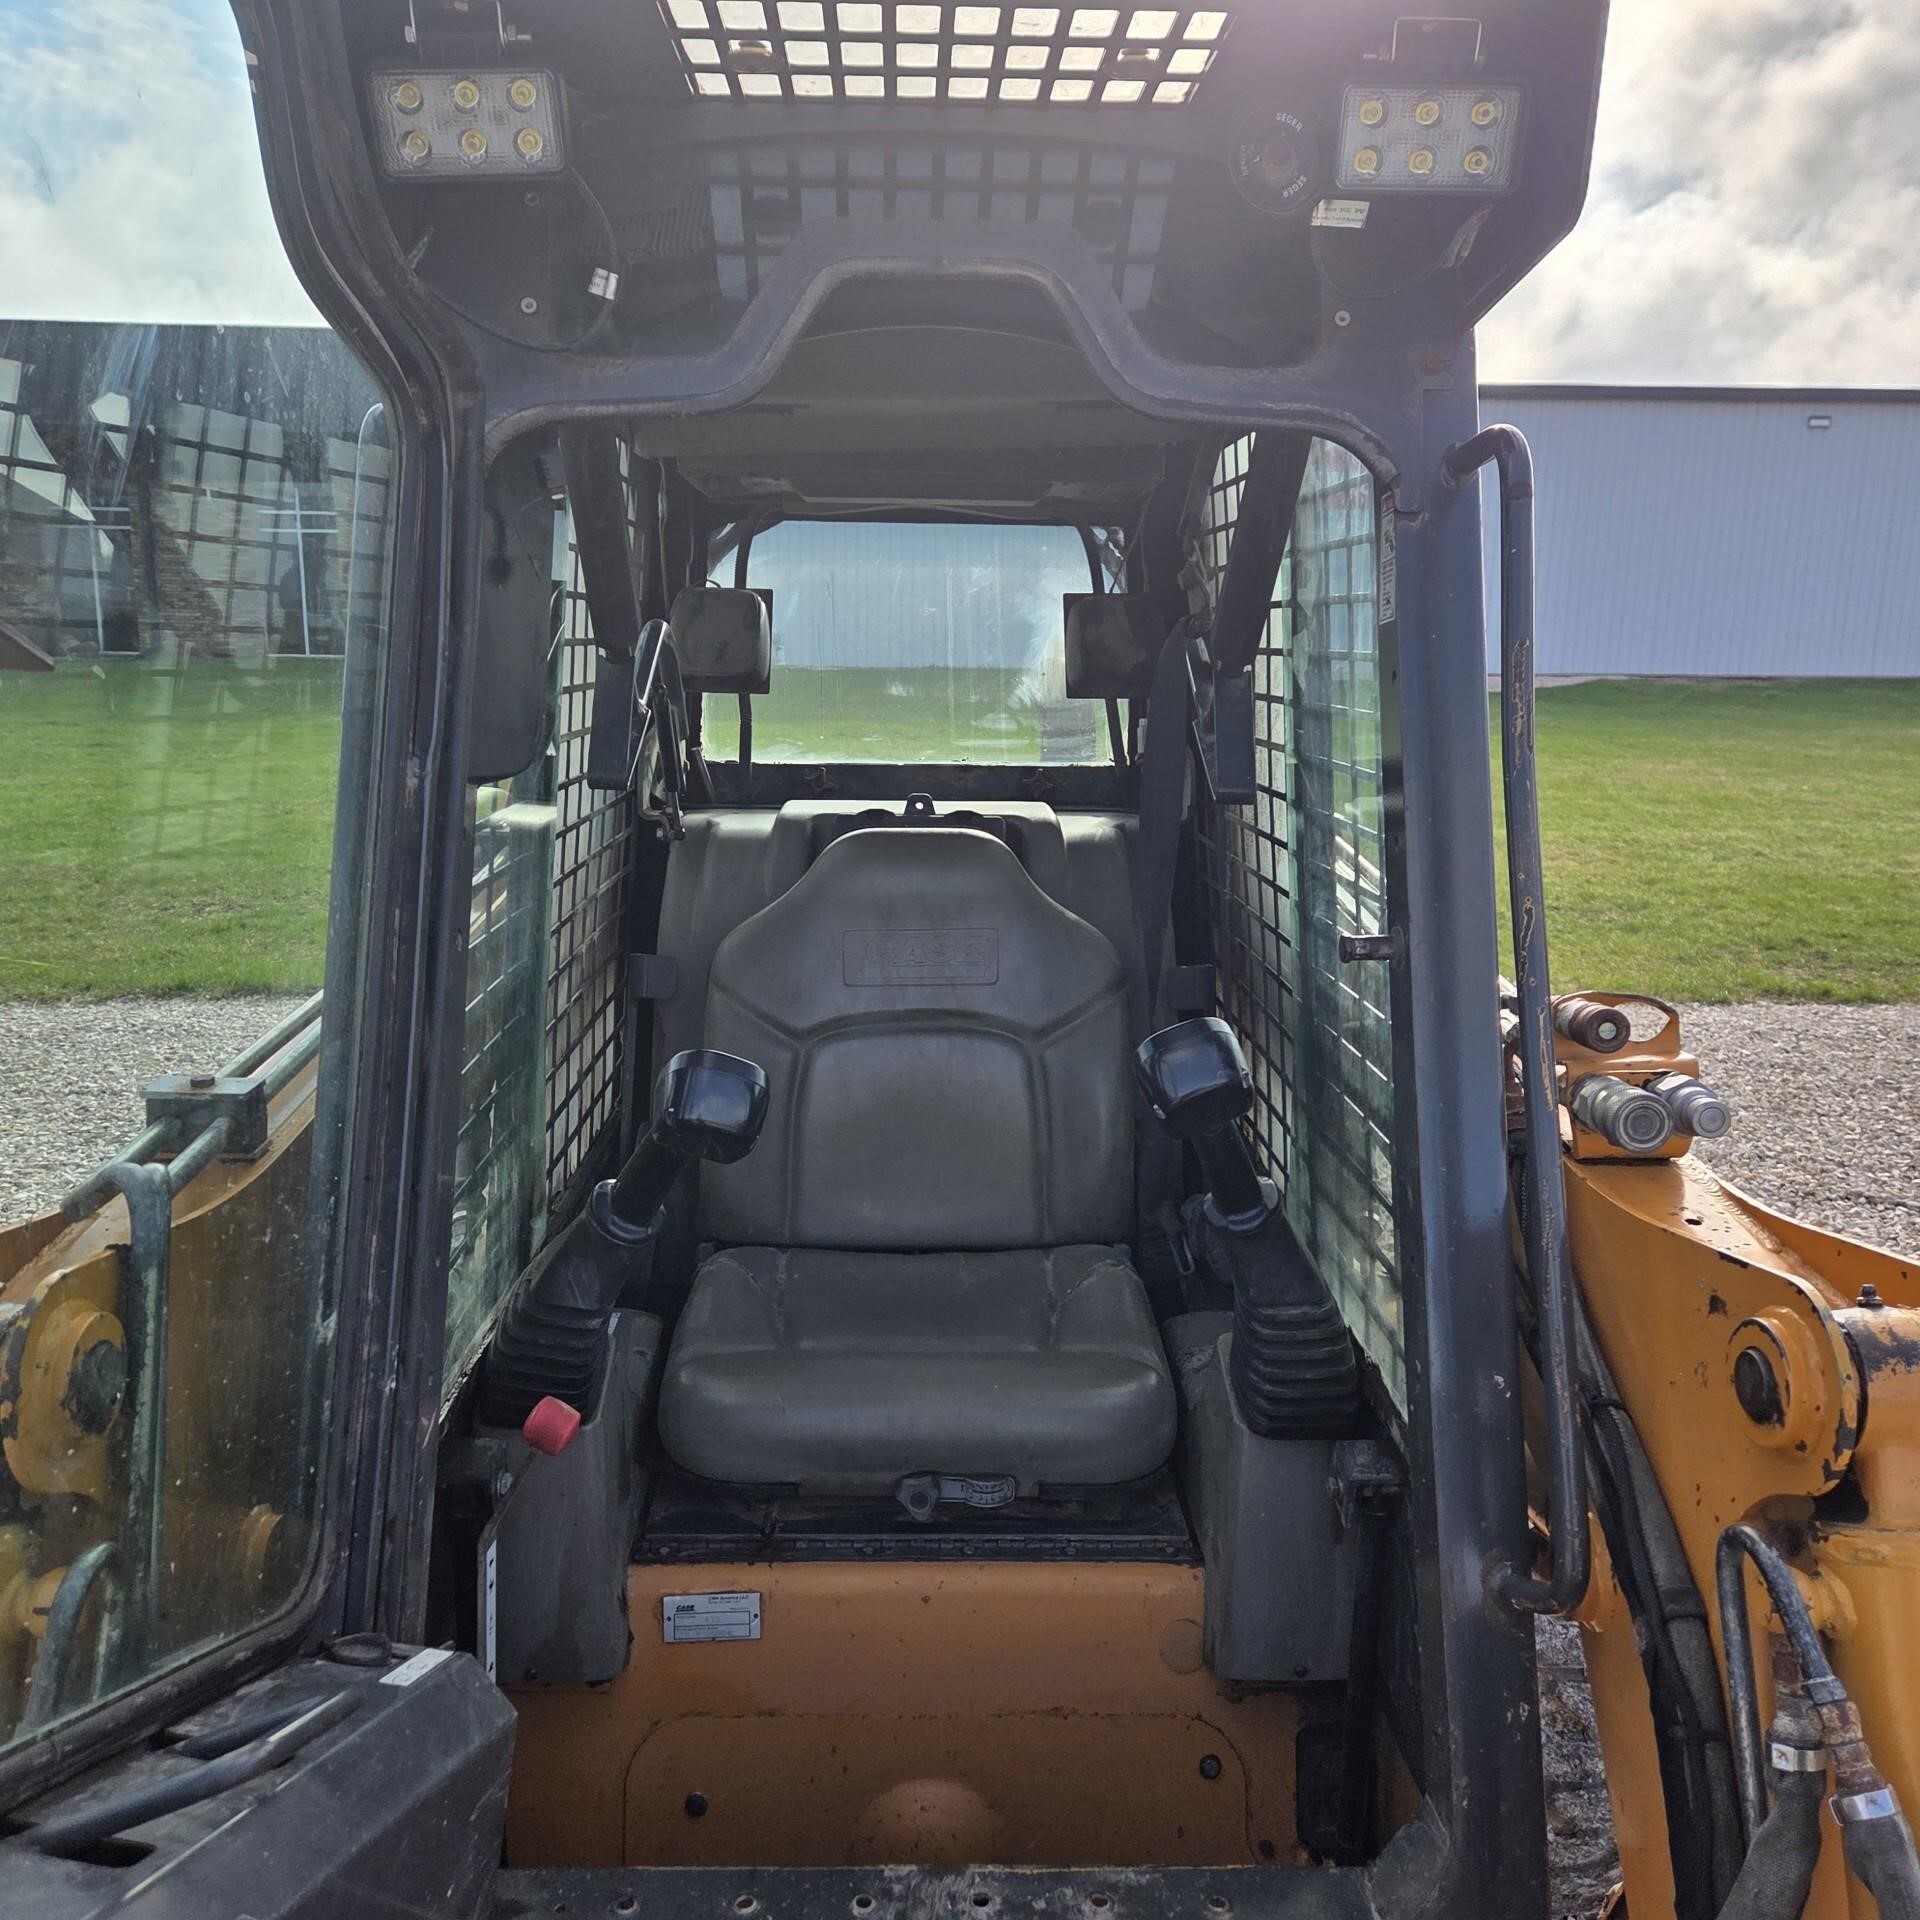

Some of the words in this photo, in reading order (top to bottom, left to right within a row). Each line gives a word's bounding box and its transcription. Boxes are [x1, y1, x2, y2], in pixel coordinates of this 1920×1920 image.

[1275, 112, 1303, 132] SEGER
[1282, 175, 1307, 198] SEGER
[675, 1604, 695, 1612] CASE
